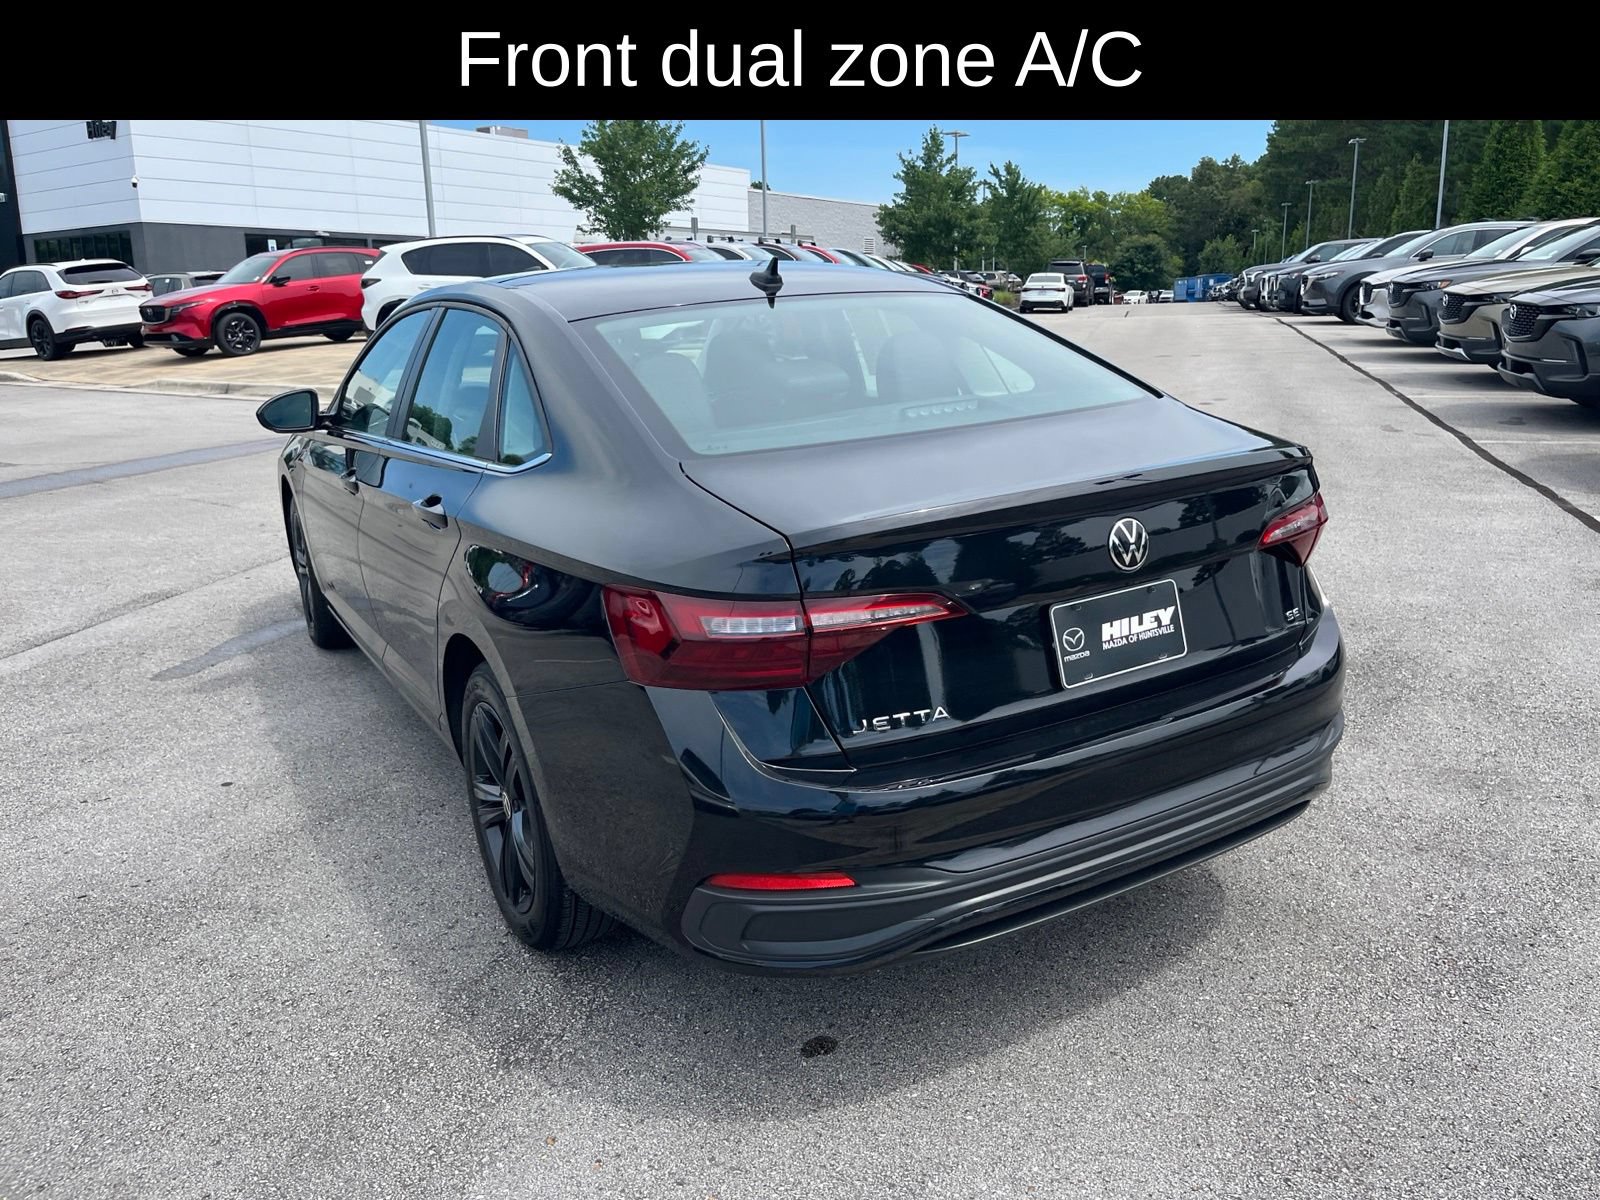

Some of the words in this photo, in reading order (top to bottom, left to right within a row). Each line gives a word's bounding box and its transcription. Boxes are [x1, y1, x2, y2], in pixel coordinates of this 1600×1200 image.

[1102, 605, 1176, 642] HILEY
[1102, 638, 1128, 651] MAZDA
[1128, 633, 1139, 644] OF
[1138, 624, 1175, 642] HUNTSVILLE
[852, 706, 952, 735] JETTA
